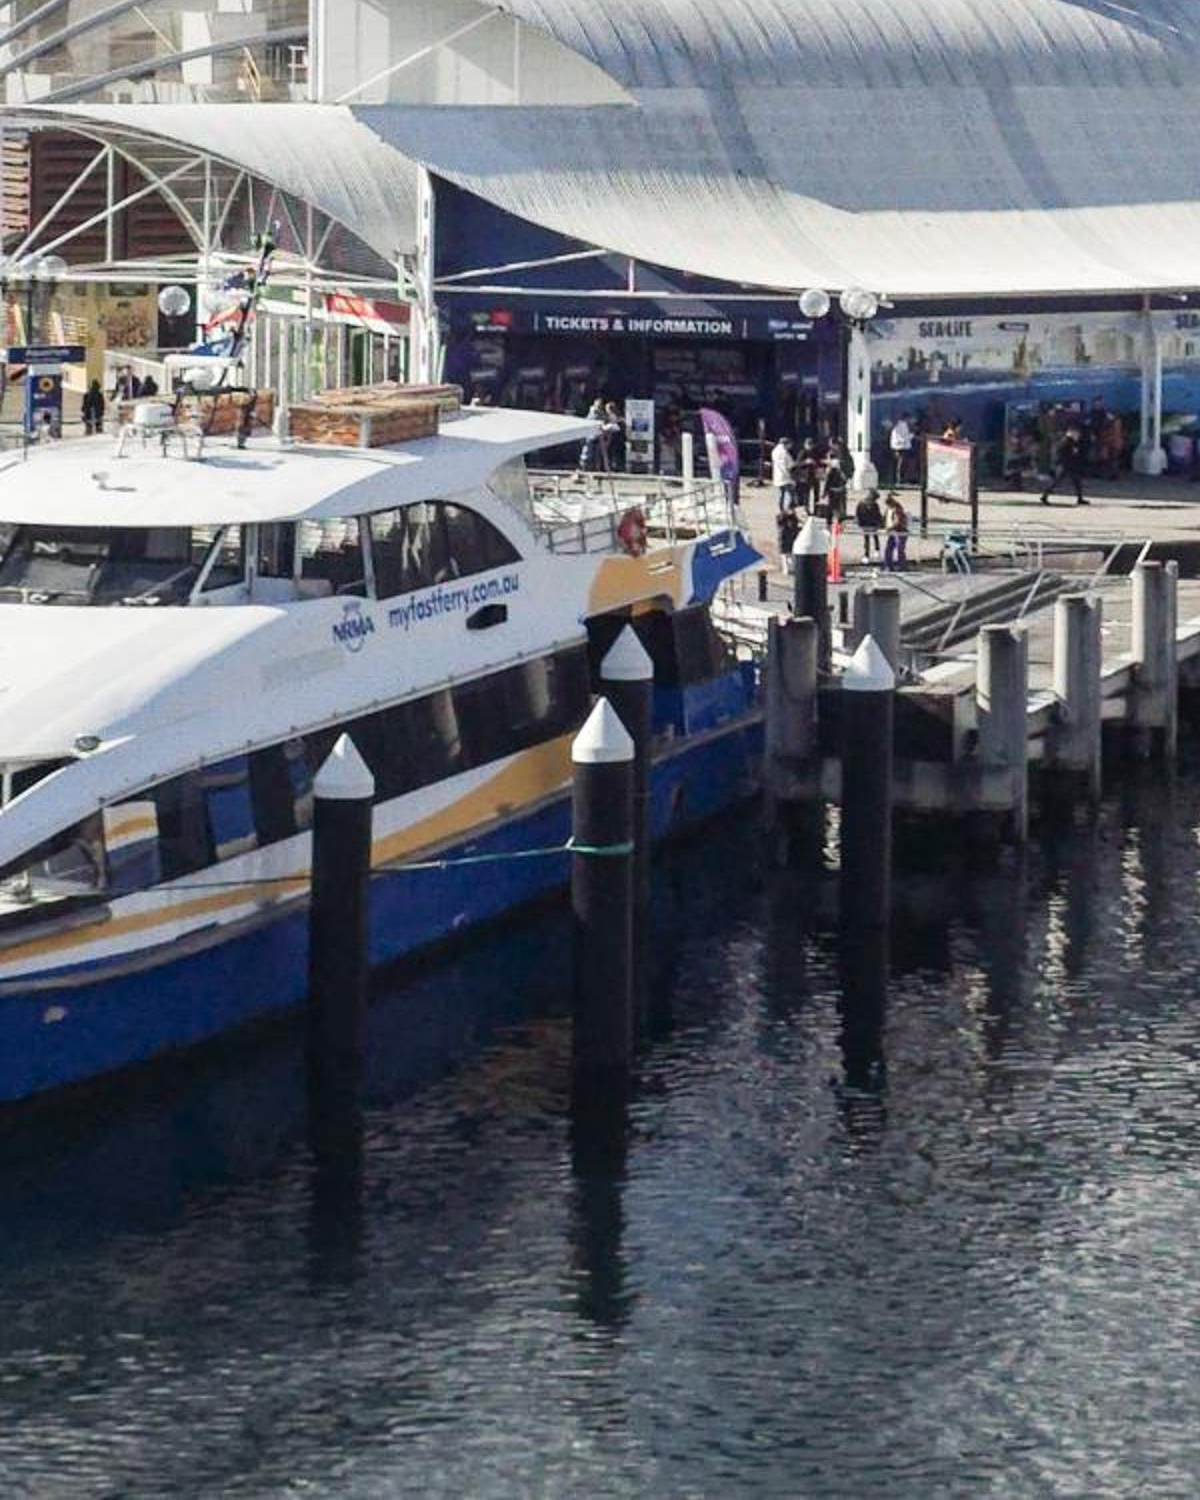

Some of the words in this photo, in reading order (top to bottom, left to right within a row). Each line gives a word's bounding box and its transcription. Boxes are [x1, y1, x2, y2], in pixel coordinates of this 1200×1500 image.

[545, 316, 609, 331] TICKETS
[613, 317, 625, 331] &
[629, 318, 733, 334] INFORMATION
[919, 321, 944, 338] SEA
[388, 573, 520, 631] myfastferry.com.au
[332, 615, 376, 644] NRMA
